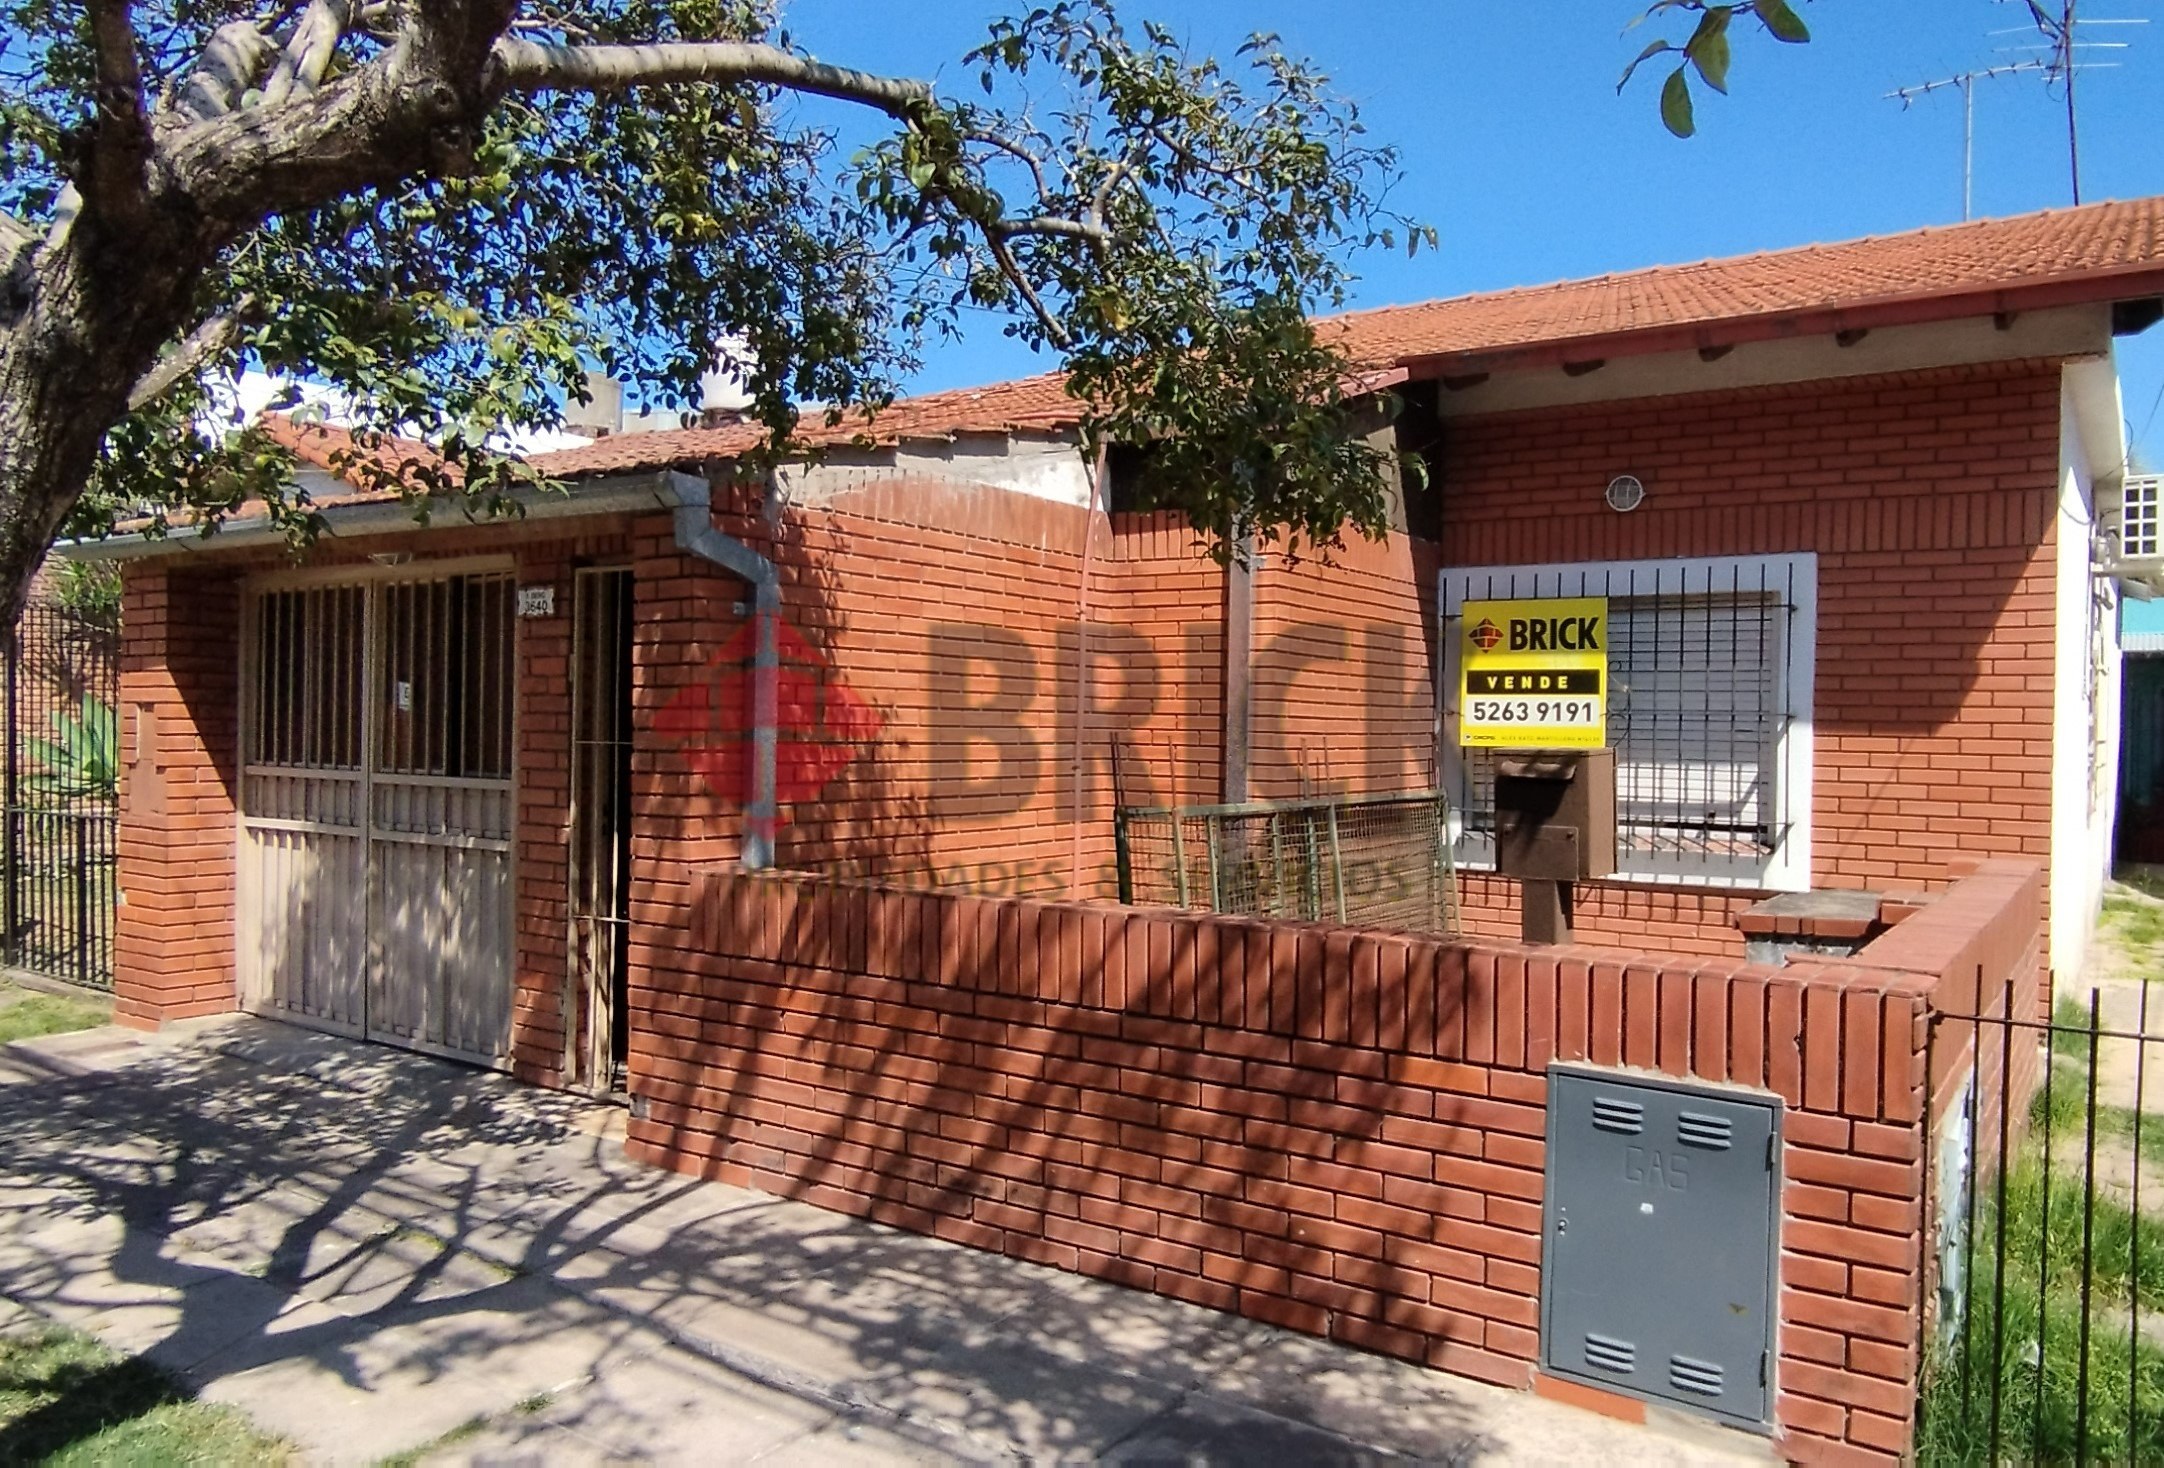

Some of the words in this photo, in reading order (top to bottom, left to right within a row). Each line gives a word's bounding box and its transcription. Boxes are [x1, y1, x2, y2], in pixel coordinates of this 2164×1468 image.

[1509, 616, 1600, 651] BRICK
[1486, 675, 1569, 690] VENDE
[1473, 701, 1529, 722] 5263
[1536, 701, 1593, 722] 9191
[1623, 1145, 1690, 1194] GAS
